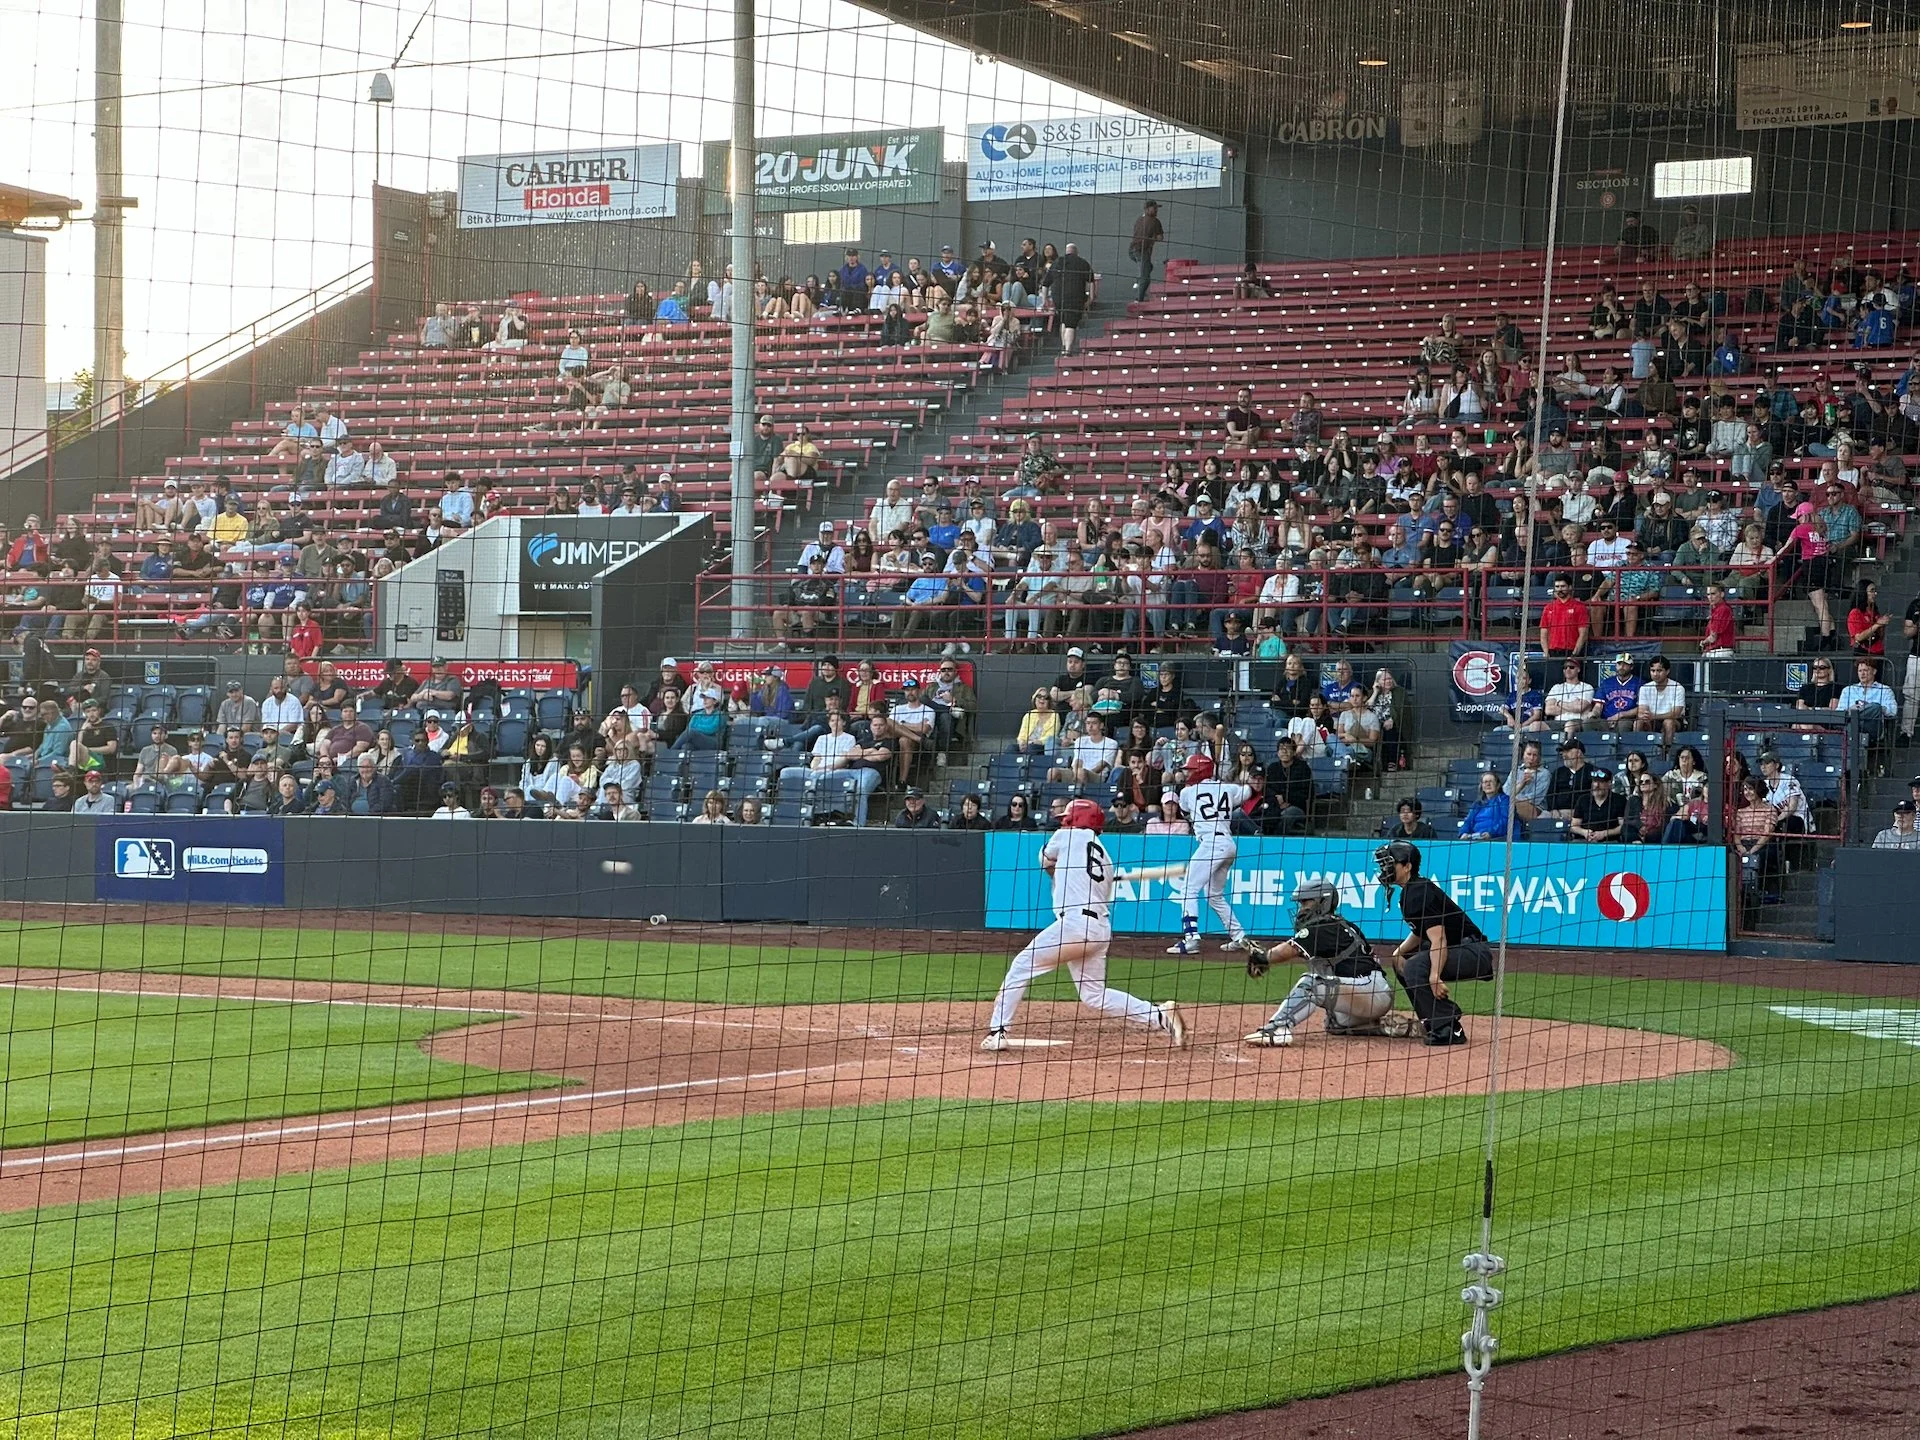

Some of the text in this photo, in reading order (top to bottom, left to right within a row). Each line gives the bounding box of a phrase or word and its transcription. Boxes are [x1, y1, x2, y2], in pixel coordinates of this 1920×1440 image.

[1042, 119, 1181, 143] S&S INSURAN
[1066, 140, 1192, 157] SERVCE
[505, 157, 629, 187] CARTER
[975, 169, 1003, 180] AUTO
[1012, 167, 1042, 178] HOME
[1051, 162, 1121, 176] COMMERCIAL
[1130, 158, 1181, 170] BENEFITS
[1191, 156, 1214, 167] LFE
[790, 182, 864, 194] PROFESSIONALLY
[979, 171, 1209, 194] www.sandsinsurance.ca (604) 324-5711
[1576, 177, 1640, 190] SECTION 2
[532, 187, 602, 208] Honda
[467, 204, 668, 224] 8th & Burrar www.carterhonda.com
[1879, 317, 1887, 330] 6
[1725, 352, 1734, 362] 4
[552, 541, 649, 565] JMMED
[577, 582, 593, 590] AD
[337, 668, 385, 681] ROGERS
[477, 669, 527, 682] ROGERS
[715, 668, 766, 682] OGERS
[919, 668, 942, 684] Fiel
[1196, 791, 1231, 820] 24
[187, 854, 264, 867] MiLB.com/tickets
[1086, 841, 1105, 883] 6
[1227, 868, 1284, 906] HE
[1431, 873, 1588, 915] FEWAY
